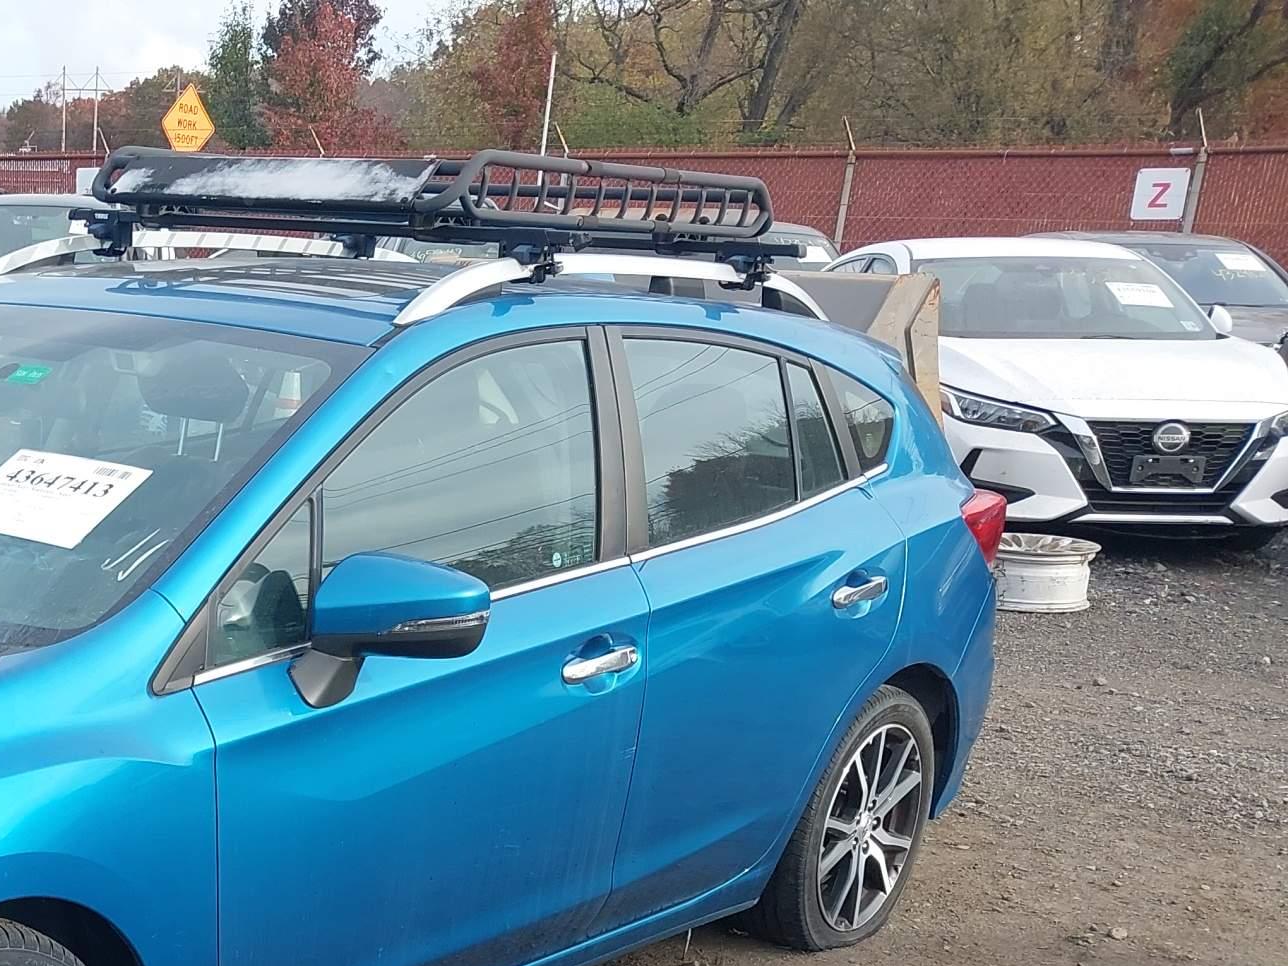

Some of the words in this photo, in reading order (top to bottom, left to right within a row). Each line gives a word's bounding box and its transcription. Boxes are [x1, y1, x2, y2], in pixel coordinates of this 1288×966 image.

[179, 103, 199, 115] ROAD
[177, 118, 197, 131] WORK
[1147, 182, 1171, 208] Z
[6, 468, 114, 498] 43647413
